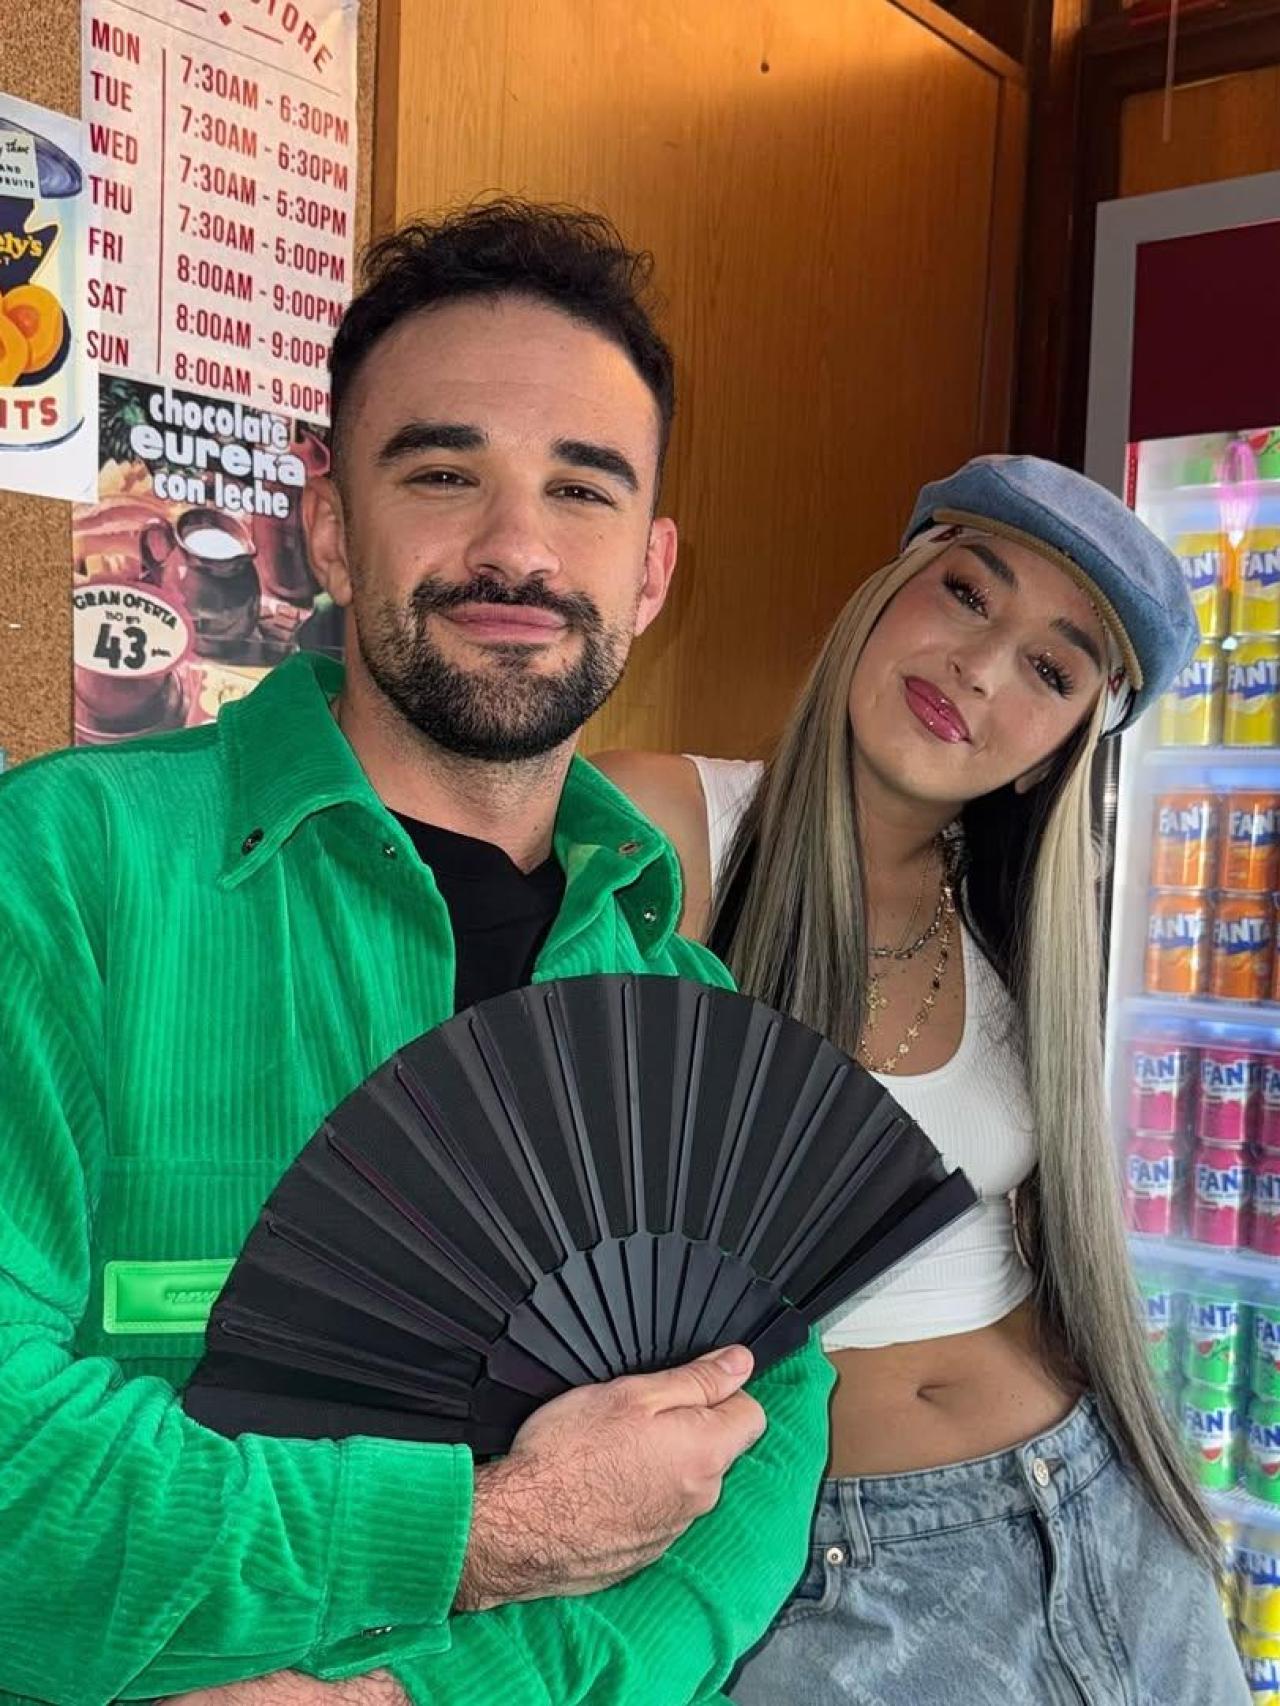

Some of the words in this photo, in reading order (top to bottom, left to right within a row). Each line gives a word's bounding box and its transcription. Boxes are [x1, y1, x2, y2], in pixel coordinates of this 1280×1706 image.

[251, 0, 333, 73] ORE
[92, 18, 139, 65] MON
[181, 55, 258, 111] 7:30AM
[280, 94, 349, 145] 6:30PM
[90, 70, 131, 112] TUE
[180, 104, 257, 158] 7:30AM
[279, 142, 348, 192] 6:30PM
[90, 123, 138, 165] WED
[180, 154, 256, 207] 7:30AM
[277, 189, 347, 237] 5:30PM
[89, 175, 132, 214] THU
[179, 203, 254, 254] 7:30AM
[276, 236, 345, 283] 5:00PM
[89, 226, 123, 263] FRI
[178, 254, 252, 301] 8:00AM
[272, 284, 344, 328] 9:00PM
[88, 278, 127, 315] SAT
[176, 304, 251, 349] 8:00AM
[87, 330, 129, 367] SUN
[175, 353, 251, 396] 8:00AM
[150, 386, 288, 449] chocolate
[131, 425, 305, 487] eureka
[154, 472, 206, 505] con
[215, 473, 290, 519] leche
[73, 591, 121, 610] GRAN
[123, 593, 177, 630] OFERTA
[93, 623, 148, 670] 43
